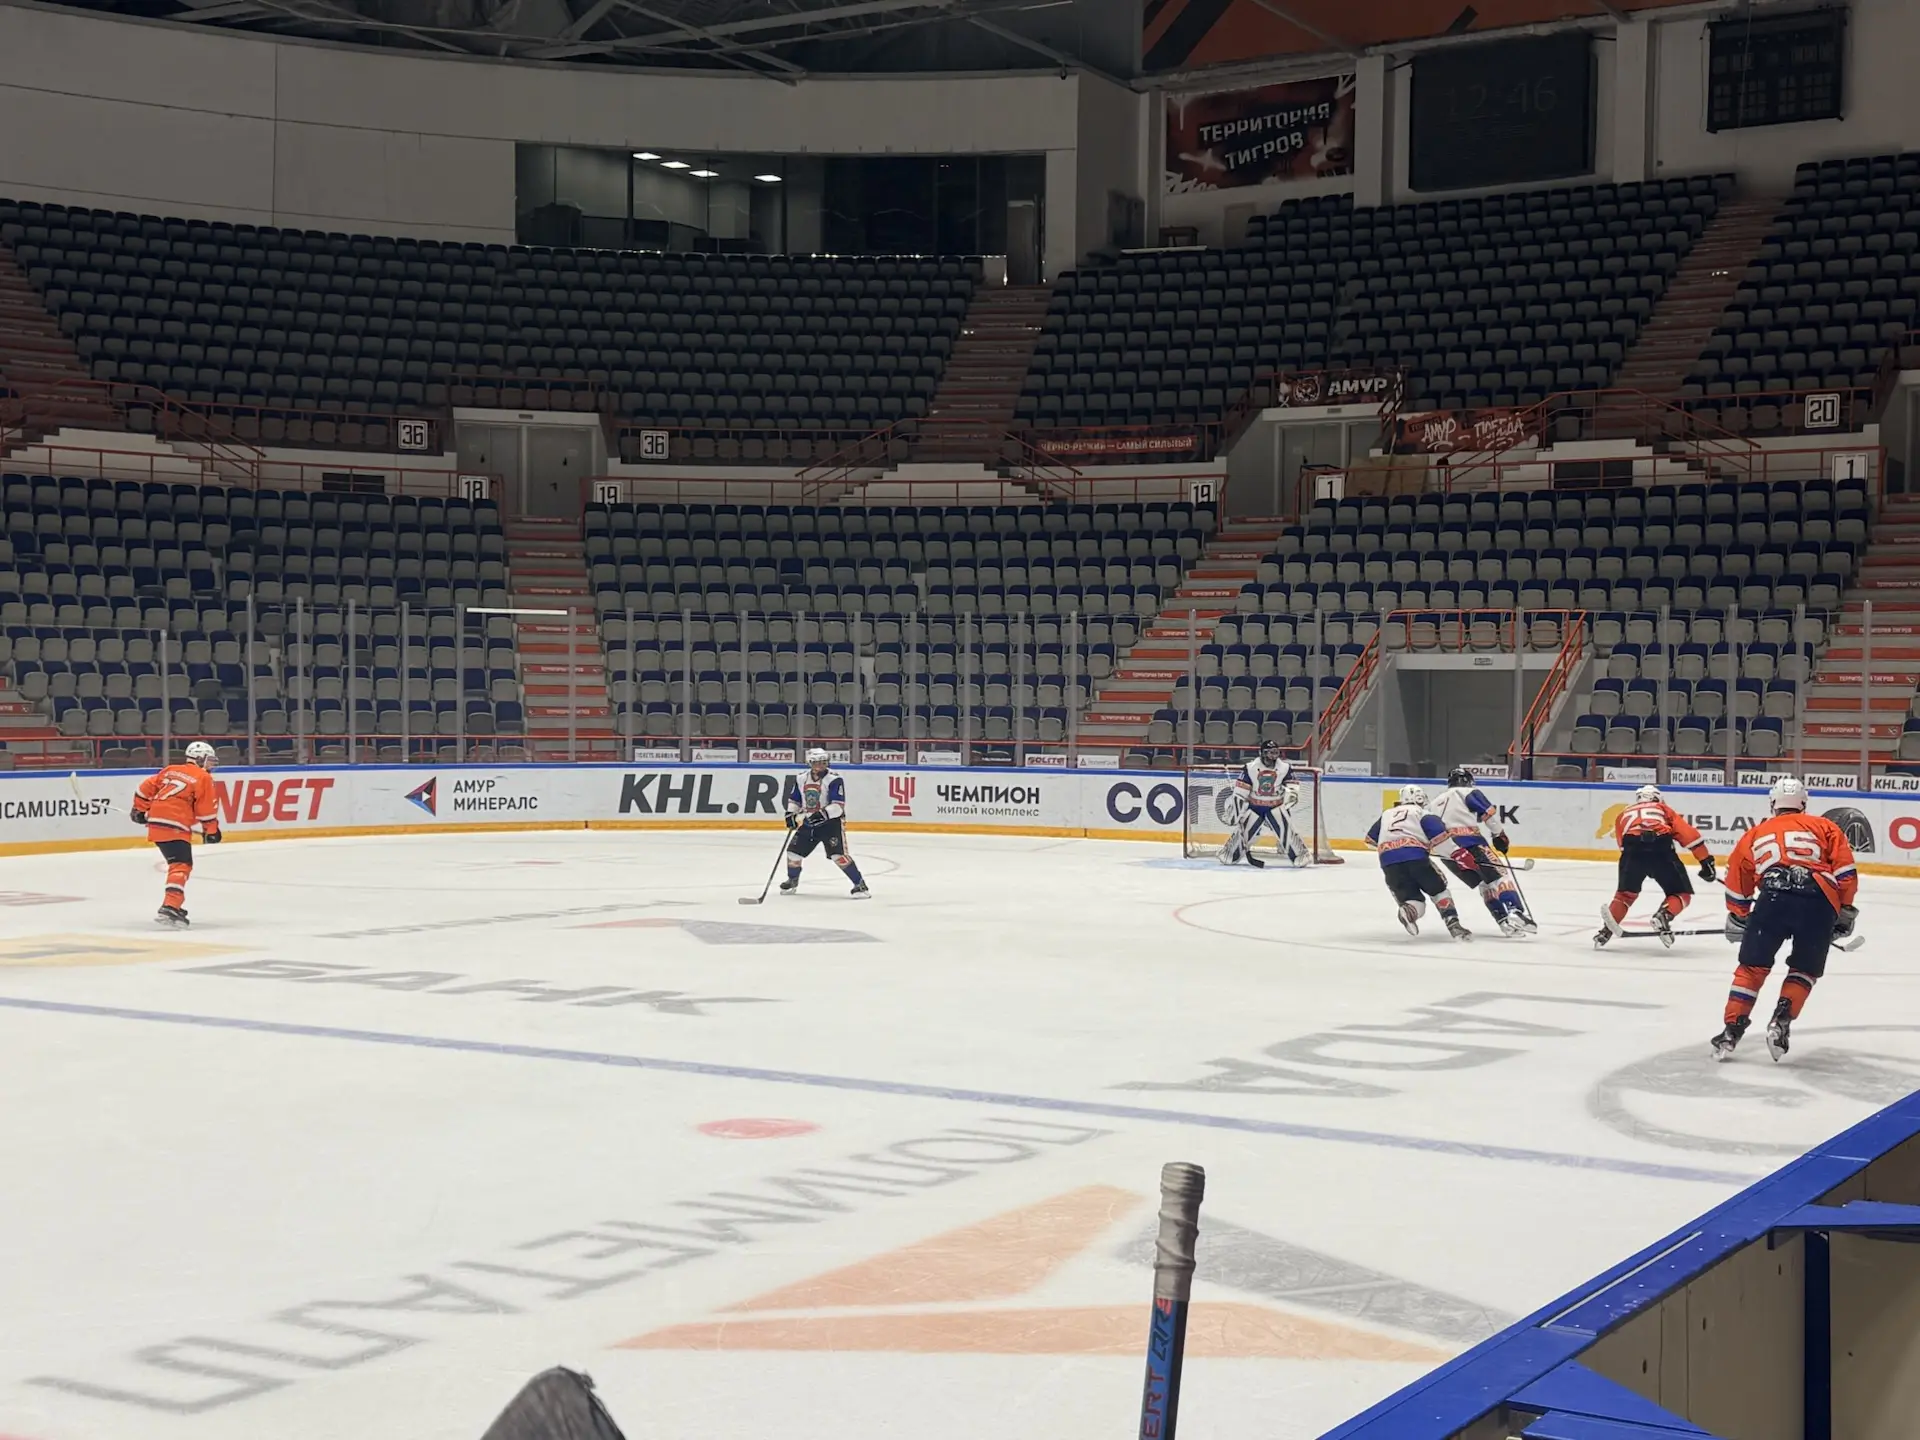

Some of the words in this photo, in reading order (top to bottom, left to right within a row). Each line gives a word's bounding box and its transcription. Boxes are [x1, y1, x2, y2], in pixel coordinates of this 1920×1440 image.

[1199, 102, 1331, 143] ТЕРРИТОРИЯ
[1225, 131, 1304, 171] ТИГРОВ
[1327, 376, 1388, 397] АМУР
[1809, 398, 1835, 423] 20
[402, 424, 424, 446] 36
[1420, 416, 1457, 443] АМУР
[643, 434, 665, 455] 36
[1846, 459, 1854, 479] 1
[464, 480, 483, 500] 18
[599, 485, 617, 503] 19
[1193, 485, 1211, 502] 19
[1327, 480, 1335, 499] 1
[452, 779, 496, 793] АМУР
[1741, 774, 1787, 785] KHL.R
[1808, 776, 1854, 788] KHL.RU
[1874, 778, 1919, 791] KHL.RU
[213, 777, 335, 824] NBET
[453, 796, 538, 811] МИНЕРАЛС
[936, 784, 1040, 804] ЧЕМПИОН
[0, 799, 110, 819] CAMUR1957
[936, 804, 978, 815] жилой
[981, 806, 1040, 817] комплекс
[1387, 810, 1408, 832] 2
[1752, 830, 1821, 875] 55
